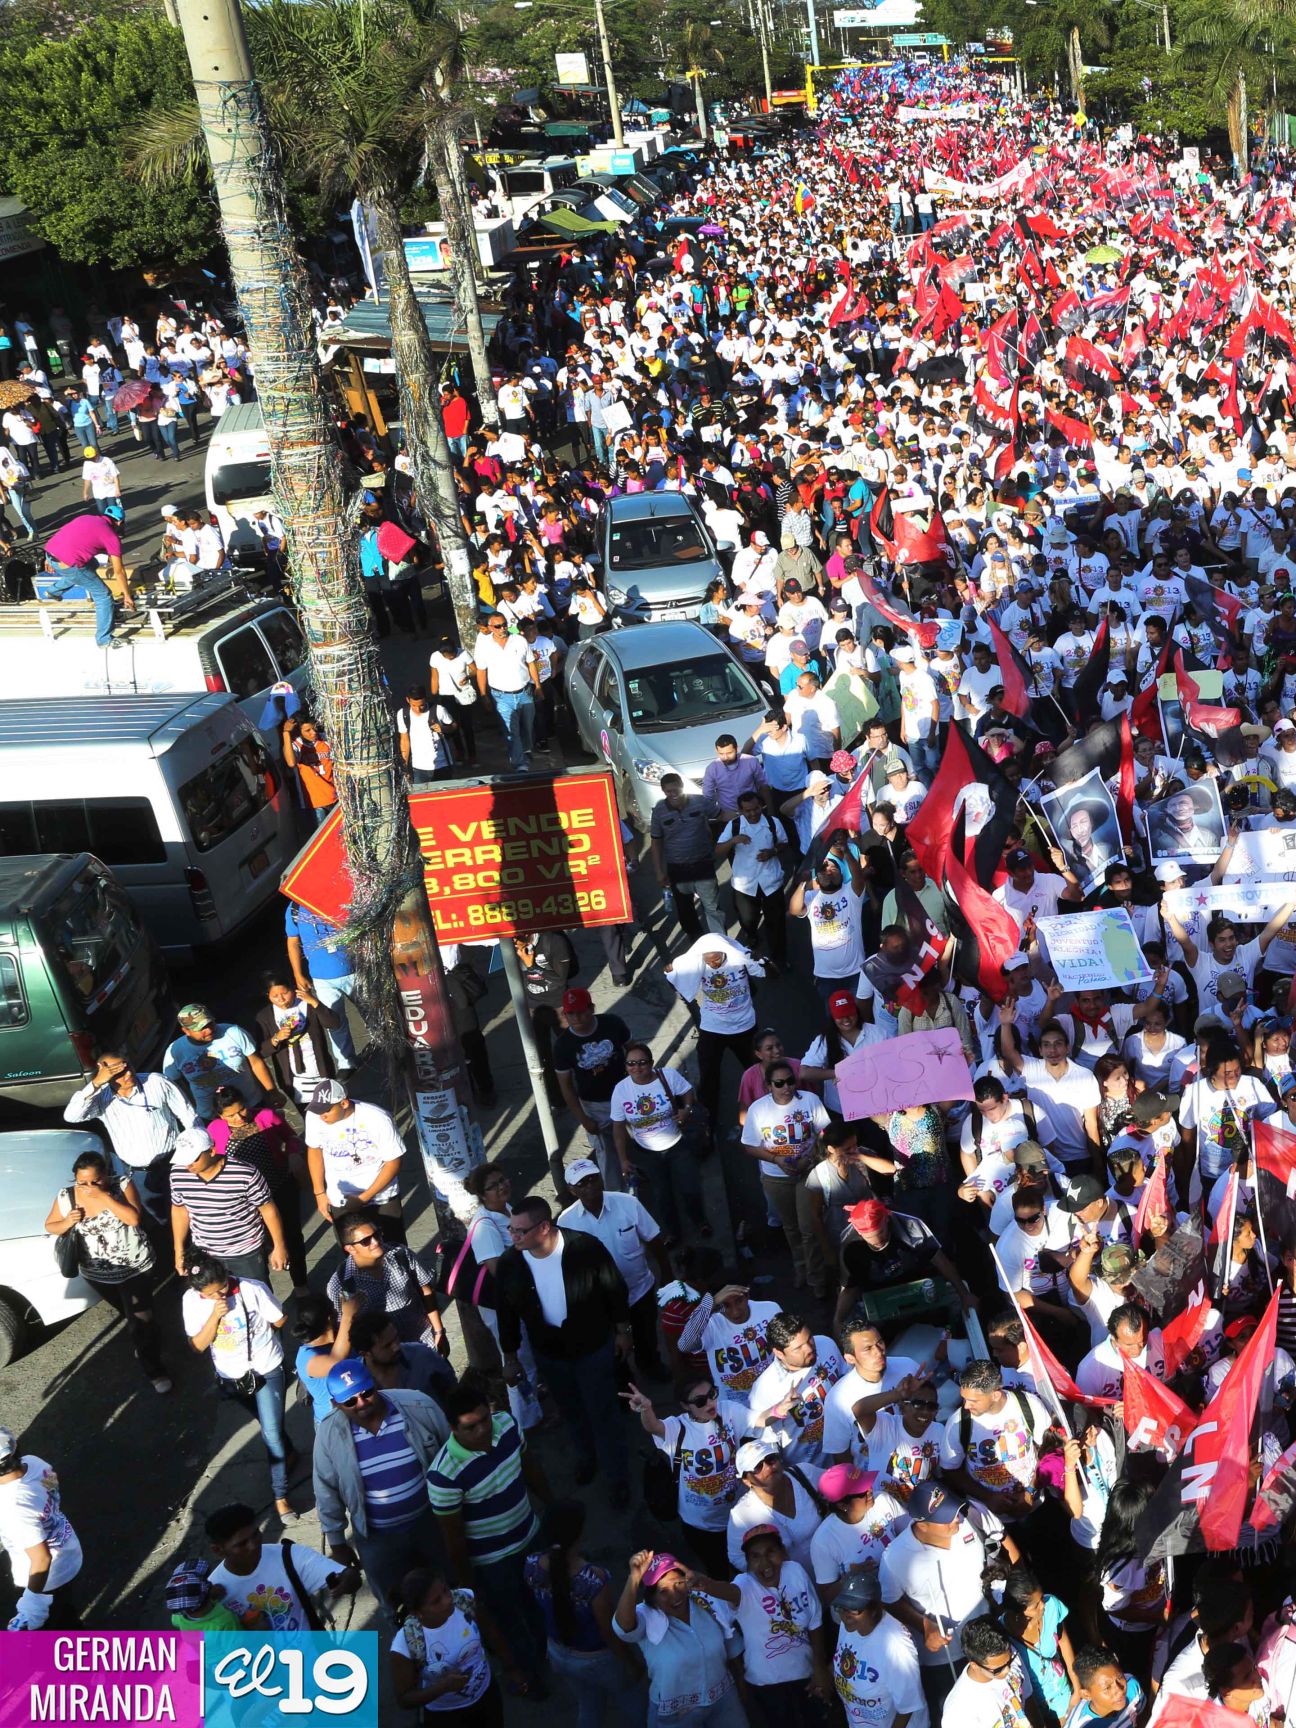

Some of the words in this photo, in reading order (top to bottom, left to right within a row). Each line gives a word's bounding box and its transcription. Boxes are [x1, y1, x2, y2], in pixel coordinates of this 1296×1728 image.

[1075, 354, 1111, 381] FSLN
[976, 404, 1012, 432] SLN
[419, 827, 437, 848] E
[449, 808, 596, 843] VENDE
[422, 833, 592, 872] ERRENO
[902, 918, 944, 991] SLN
[1056, 958, 1106, 969] VIDA!
[4, 1070, 42, 1079] Saloon
